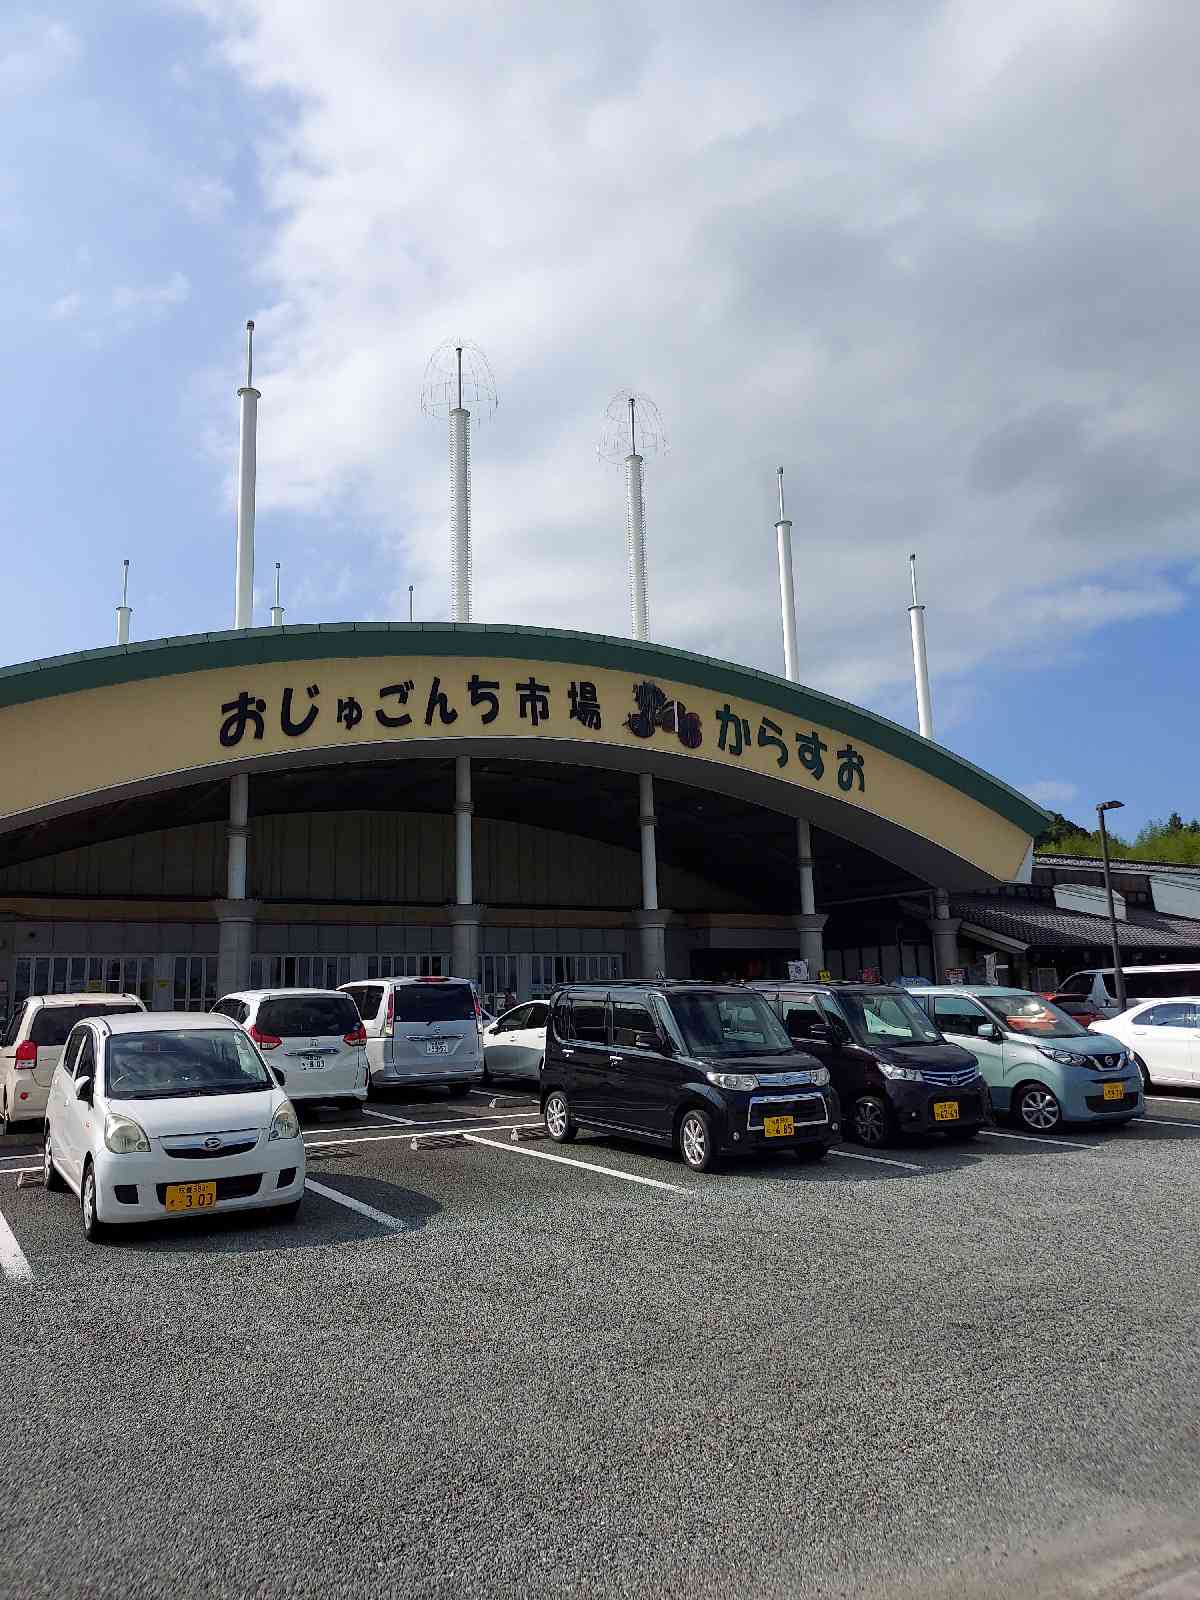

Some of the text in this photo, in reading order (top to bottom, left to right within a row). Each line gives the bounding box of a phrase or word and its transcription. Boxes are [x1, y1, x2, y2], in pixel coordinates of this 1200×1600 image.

[219, 674, 865, 792] おじゅごんち市場 からすお
